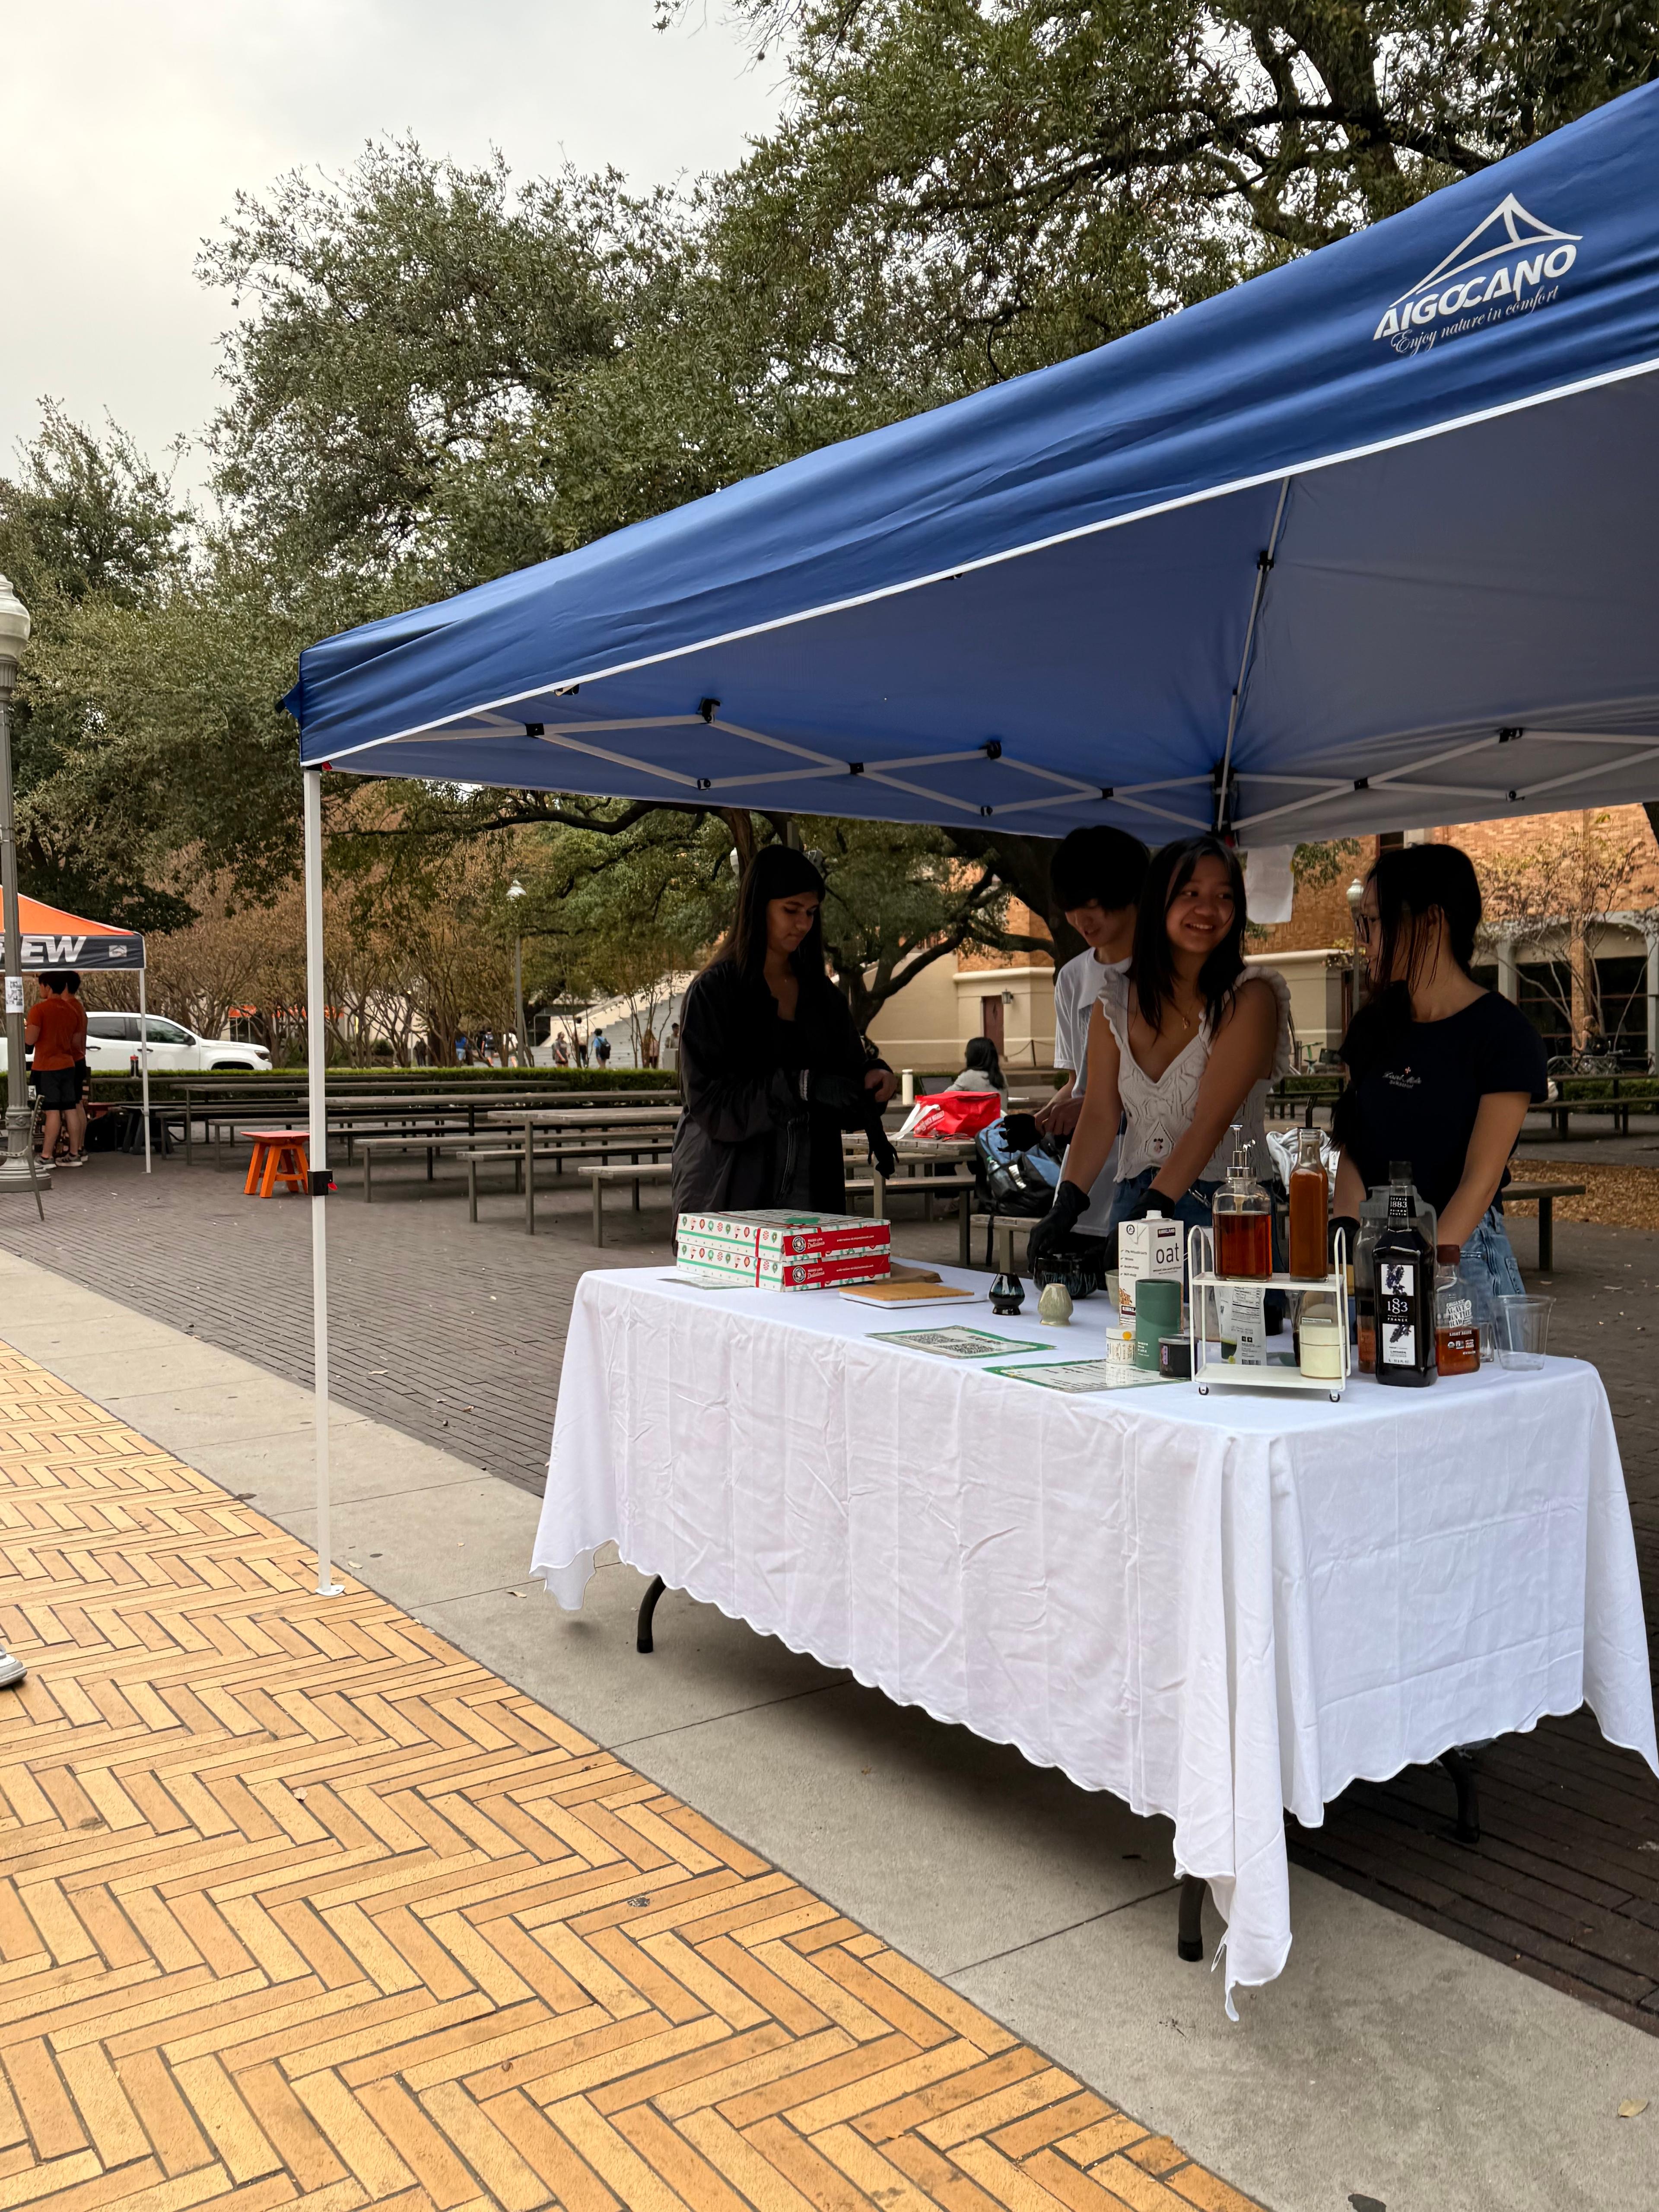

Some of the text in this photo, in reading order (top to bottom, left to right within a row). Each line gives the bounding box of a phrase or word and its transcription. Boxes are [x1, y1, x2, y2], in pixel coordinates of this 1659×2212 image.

[1373, 245, 1576, 340] AIGOCANO
[1391, 285, 1559, 357] Enjoy nature in comfort
[0, 936, 86, 963] EW
[1156, 1243, 1179, 1264] oat
[1388, 1298, 1408, 1314] 1883
